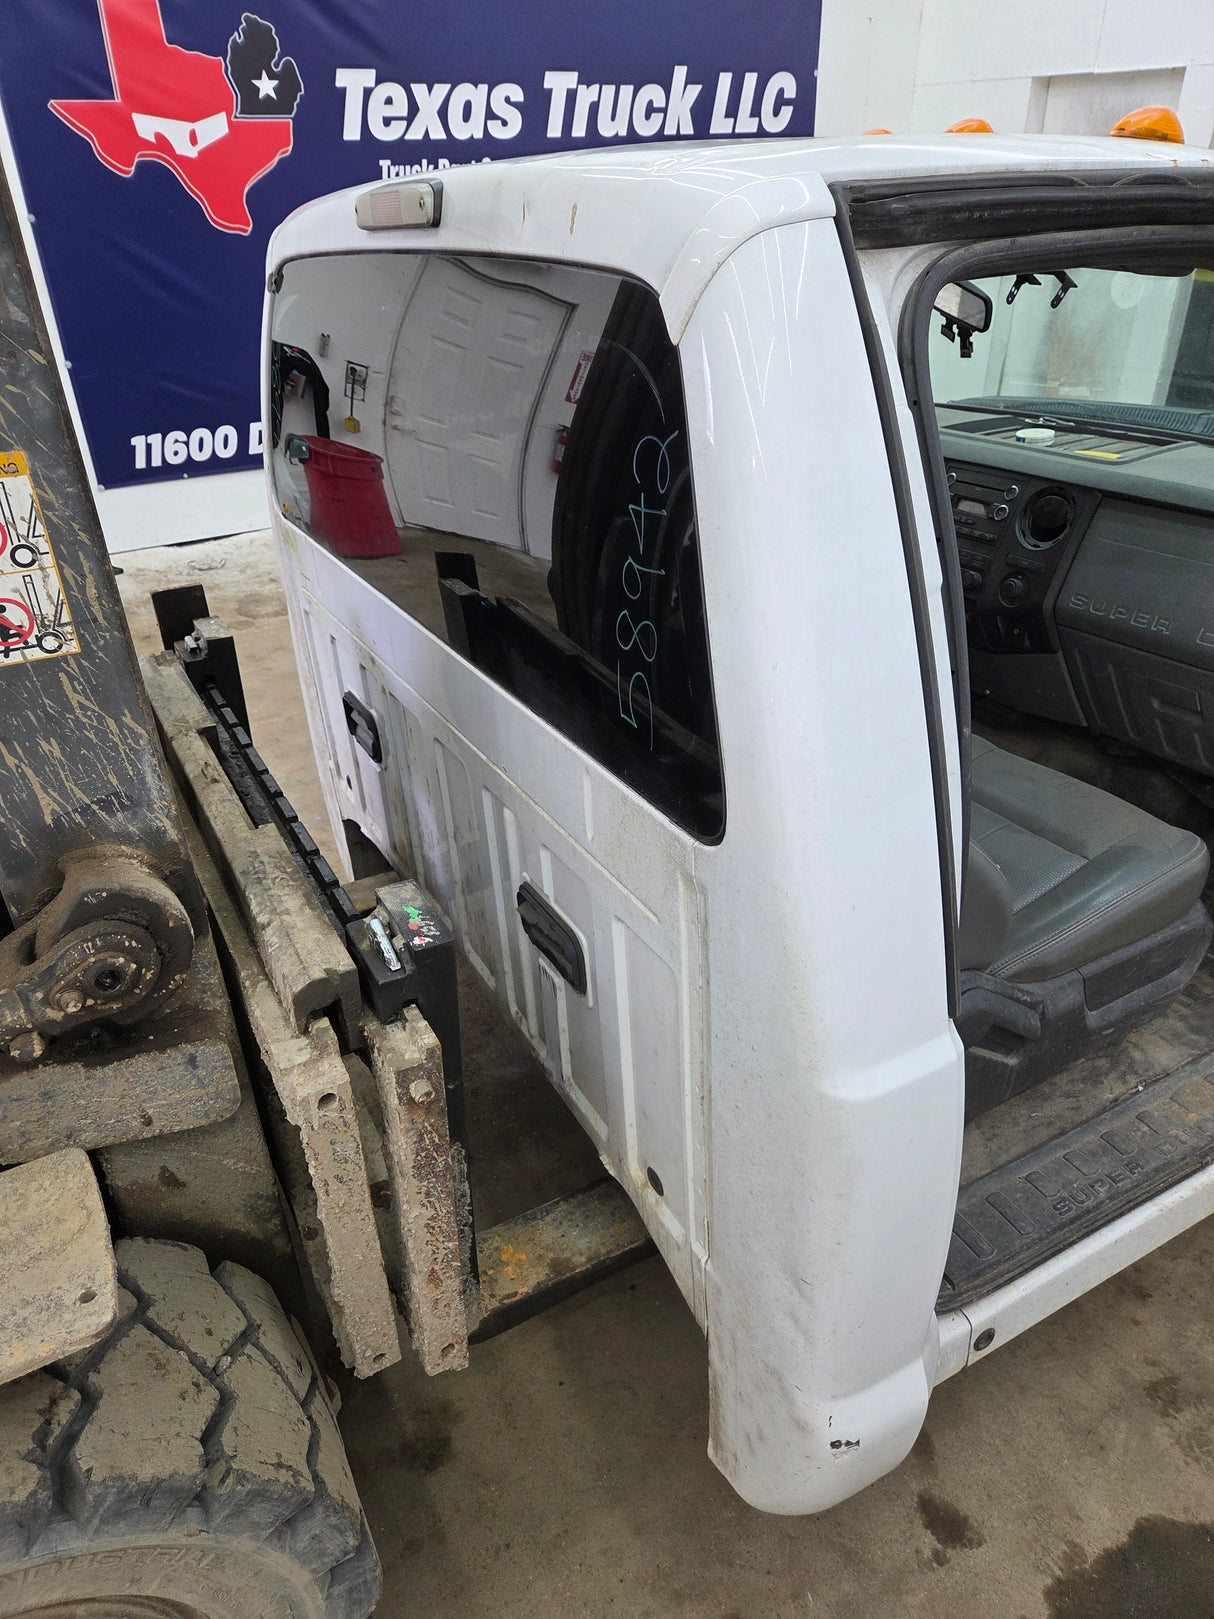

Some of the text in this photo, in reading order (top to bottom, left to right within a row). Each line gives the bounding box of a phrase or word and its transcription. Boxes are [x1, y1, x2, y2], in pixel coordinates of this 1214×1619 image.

[335, 65, 797, 141] Texas Truck LLC
[131, 425, 238, 469] 11600
[616, 430, 678, 751] 58942
[1069, 594, 1173, 635] SUPER
[1051, 1160, 1145, 1217] SUPER
